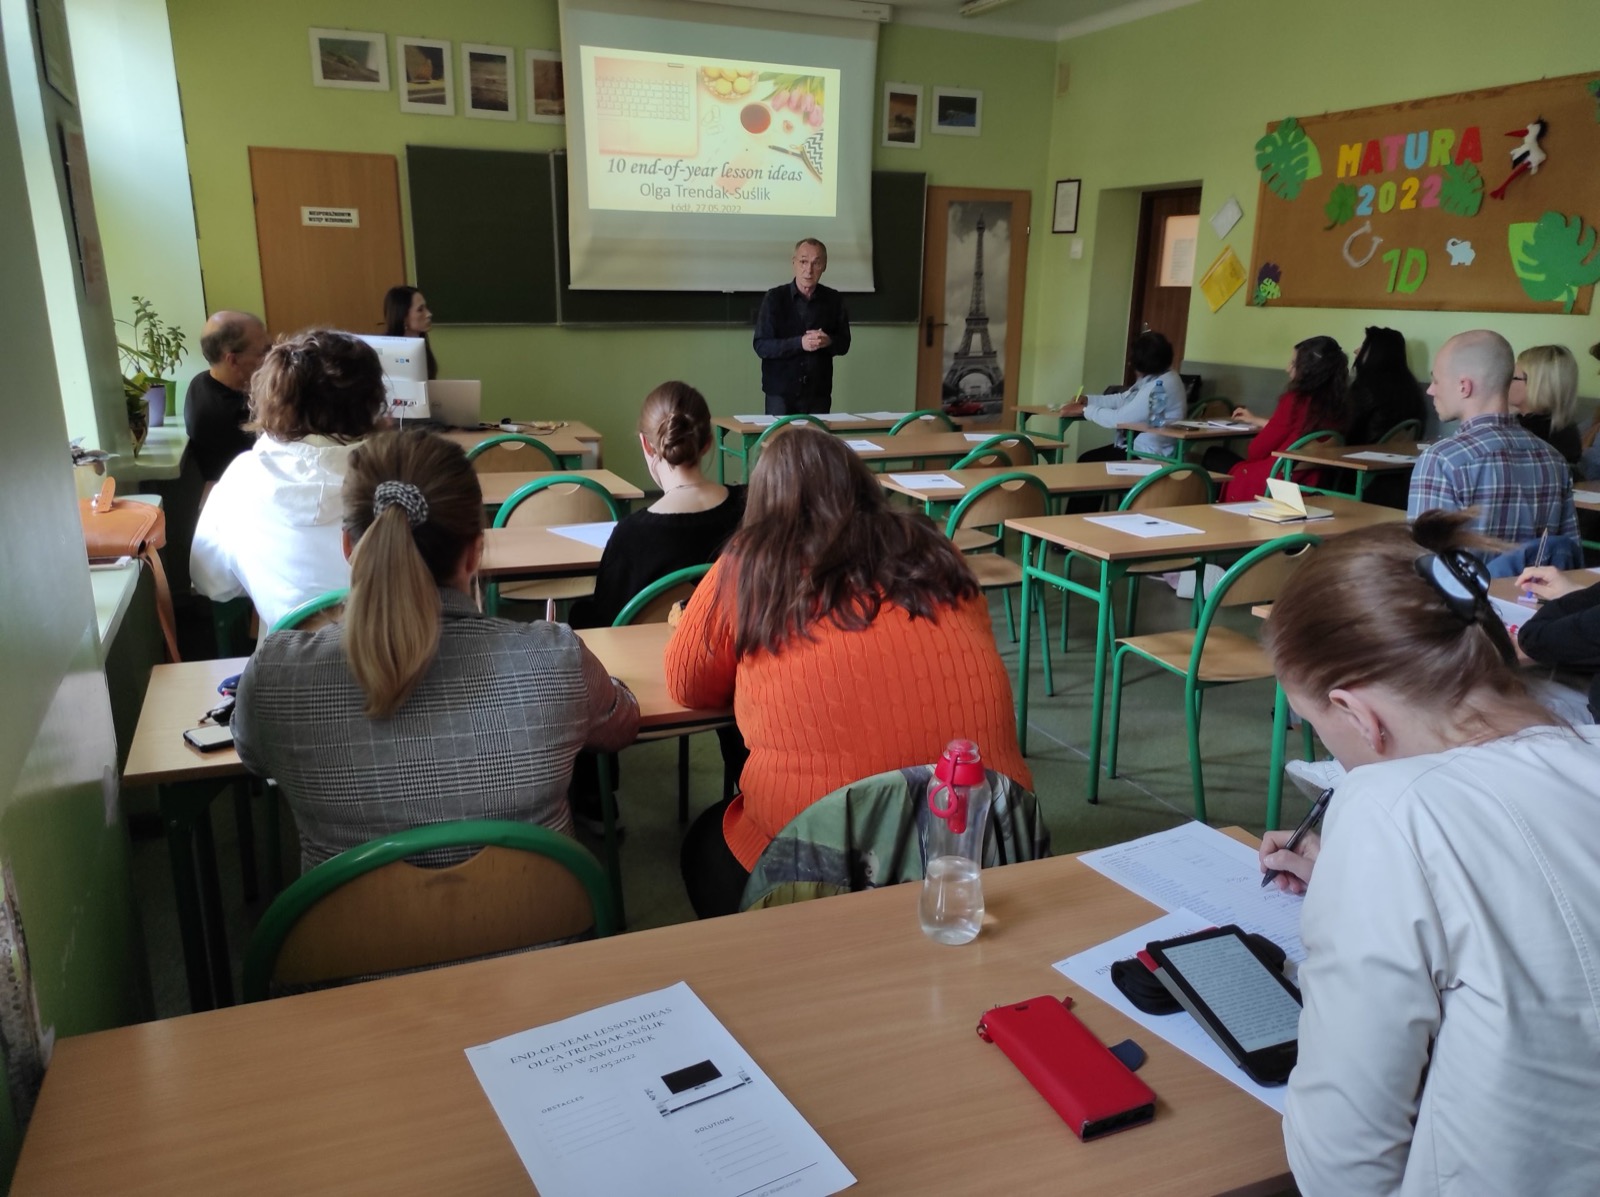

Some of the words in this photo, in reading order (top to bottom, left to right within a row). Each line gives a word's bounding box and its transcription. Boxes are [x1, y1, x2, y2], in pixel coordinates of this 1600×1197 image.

[1337, 127, 1482, 178] MATURA
[608, 157, 626, 173] 10
[630, 159, 718, 182] end-of-year
[721, 161, 763, 180] lesson
[767, 164, 803, 182] ideas
[640, 182, 671, 199] Olga
[676, 184, 771, 201] Trendak-Suślik
[1356, 176, 1443, 217] 2022
[1382, 248, 1428, 294] 1D
[510, 1033, 592, 1064] END-OF-YEAR
[594, 1018, 638, 1036] LESSON
[638, 1006, 673, 1022] IDEAS
[528, 1053, 565, 1070] OLGA
[552, 1061, 574, 1074] SJO
[575, 1034, 656, 1064] WAWRZONEK
[588, 1053, 636, 1073] 27.05.2022
[541, 1095, 584, 1114] OBSTACLES
[694, 1116, 735, 1134] SOLUTIONS
